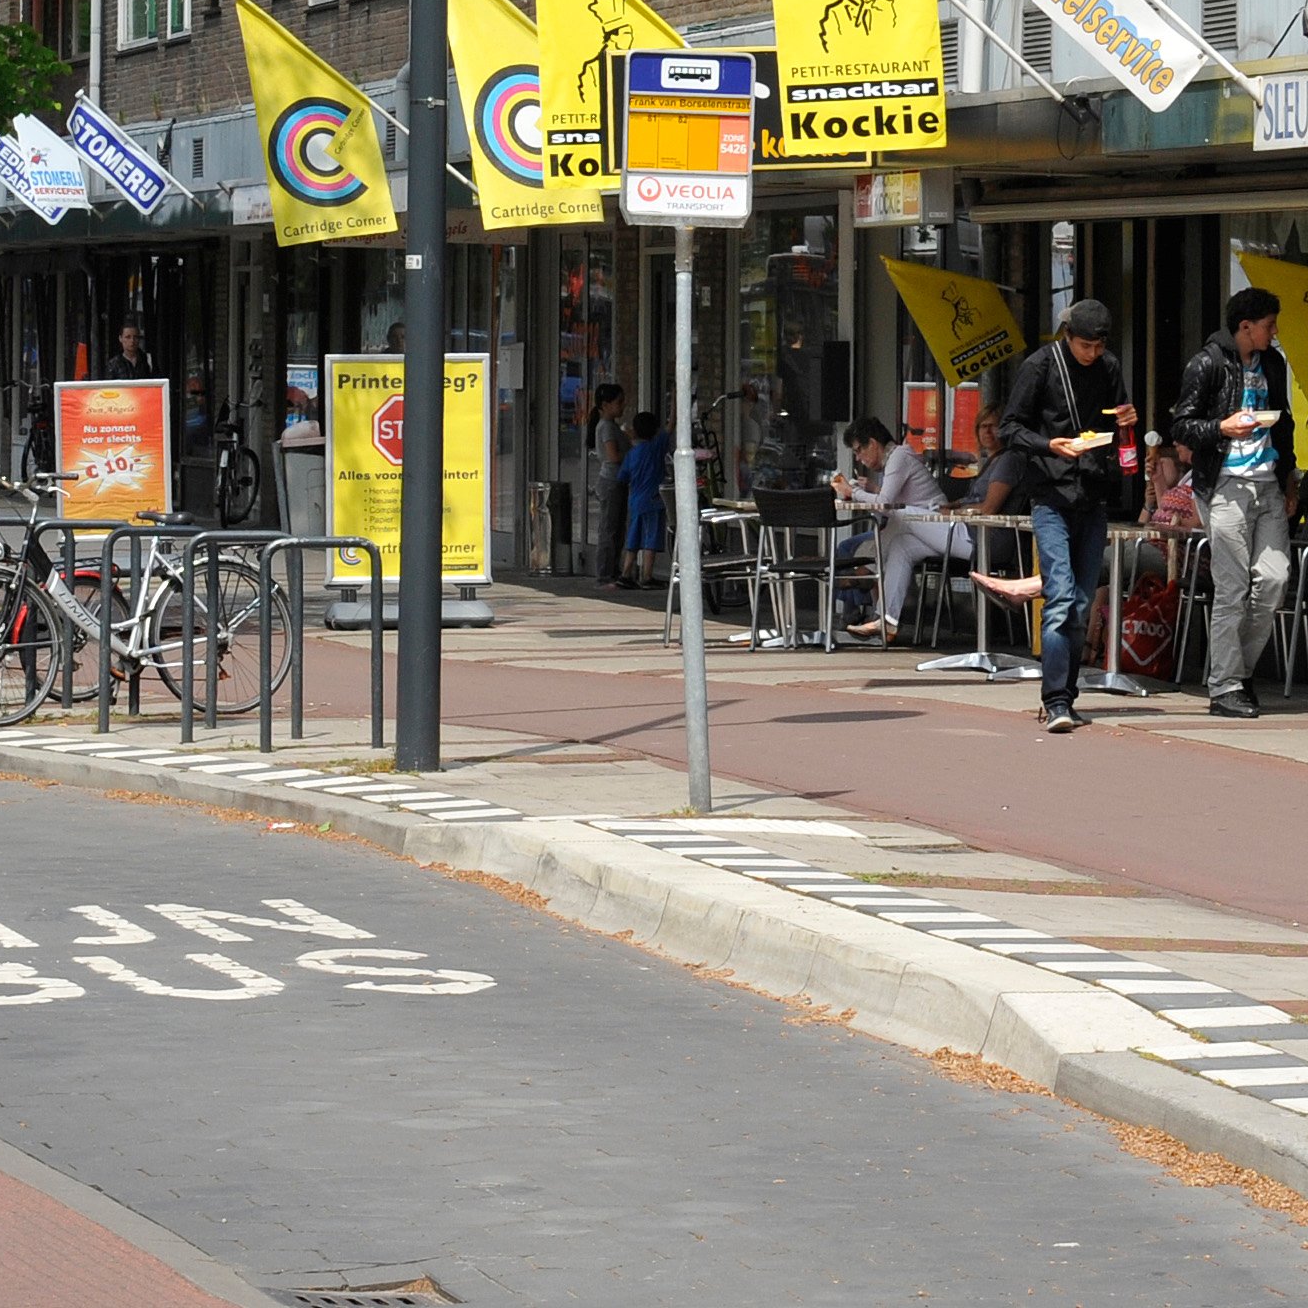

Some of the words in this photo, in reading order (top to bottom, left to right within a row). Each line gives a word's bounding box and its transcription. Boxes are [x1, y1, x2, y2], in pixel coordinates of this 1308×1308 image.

[791, 60, 931, 78] PETIT-RESTAURANT
[791, 81, 935, 101] snackbar
[629, 96, 655, 106] Frank
[659, 98, 676, 106] van
[680, 99, 750, 110] Borselenstraat
[791, 105, 939, 140] Kockie
[723, 134, 745, 142] ZONE
[720, 144, 747, 154] 5426
[71, 115, 159, 202] STOMERIJ
[31, 170, 83, 187] STOMERIJ
[667, 185, 735, 199] VEOLIA
[491, 202, 554, 220] Cartridge
[559, 202, 601, 215] Corner
[667, 202, 724, 211] TRANSPORT
[283, 220, 342, 238] Cartridge
[347, 216, 387, 229] Corner
[956, 343, 1014, 380] Kockie
[338, 374, 403, 390] Printe
[443, 373, 478, 392] eg?
[84, 425, 97, 433] Nu
[100, 425, 136, 433] zonnen
[380, 420, 404, 440] ST
[107, 434, 142, 444] slechts
[338, 470, 370, 480] Alles
[375, 472, 403, 480] voor
[444, 470, 479, 480] inter!
[369, 516, 394, 524] Papier
